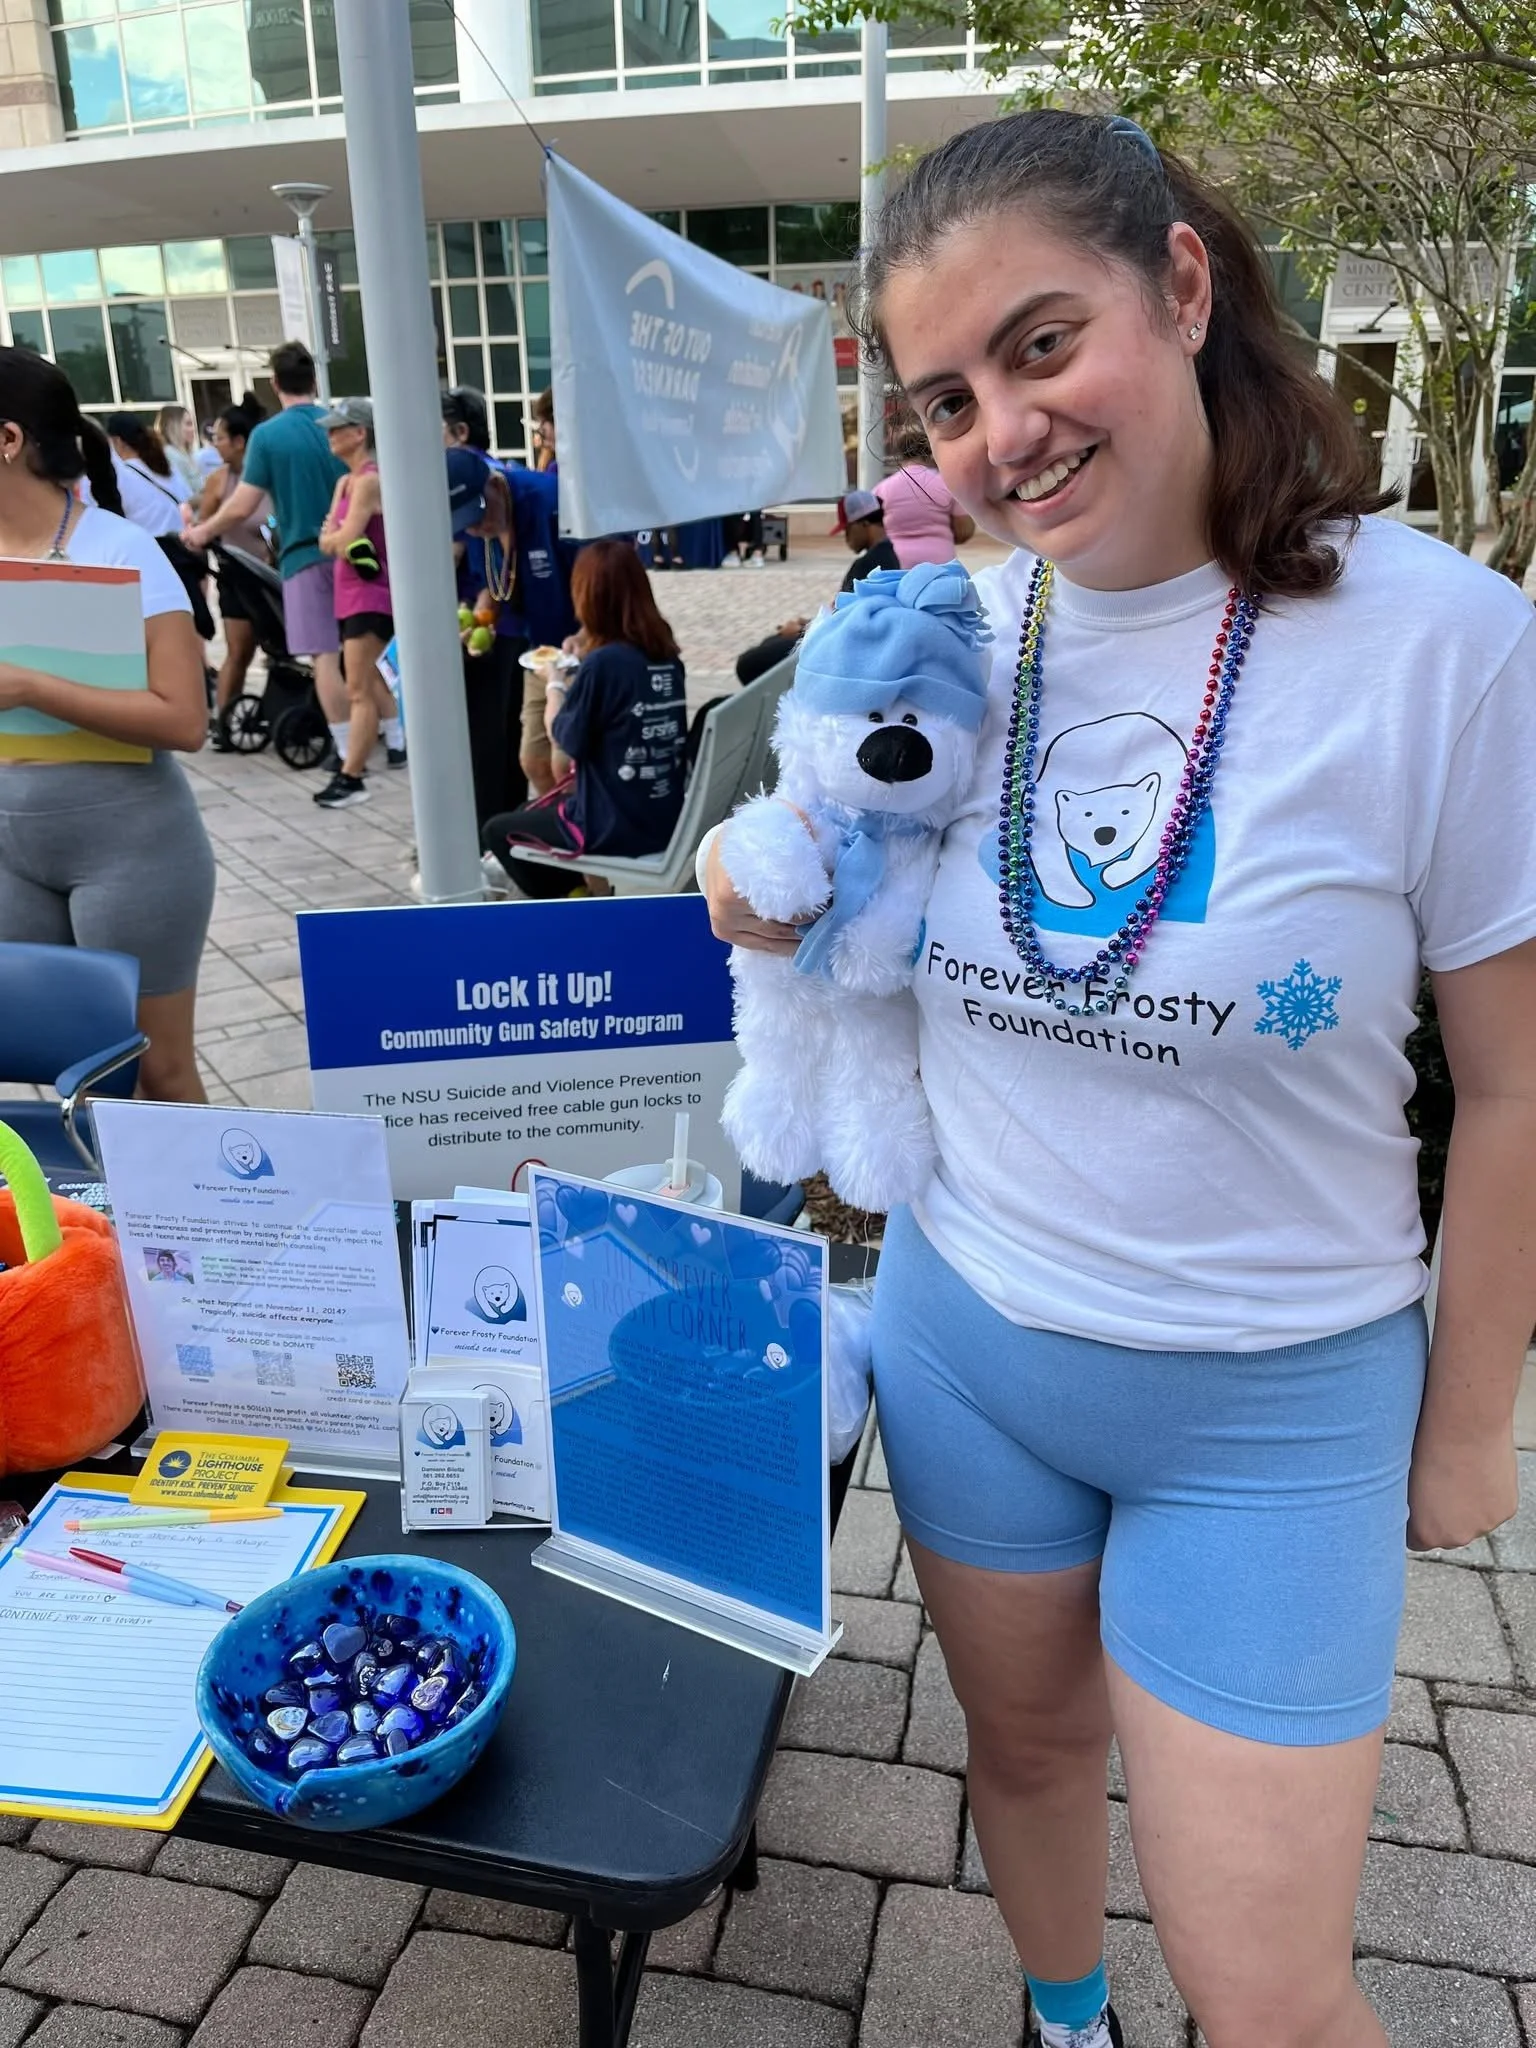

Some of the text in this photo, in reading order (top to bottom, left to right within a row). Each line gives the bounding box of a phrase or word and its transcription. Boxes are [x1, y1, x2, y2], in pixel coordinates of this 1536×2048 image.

[456, 971, 612, 1011] Lock it Up!
[928, 942, 1236, 1036] Forever Frosty
[380, 1013, 683, 1051] Community Gun Safety Program
[963, 998, 1181, 1066] Foundation
[364, 1070, 701, 1108] The NSU Suicide and Violence Prevention
[419, 1112, 449, 1127] has
[454, 1106, 523, 1123] received
[528, 1102, 558, 1117] free
[564, 1098, 604, 1114] cable
[610, 1099, 639, 1115] gun
[644, 1093, 682, 1109] locks
[686, 1092, 702, 1105] to
[428, 1118, 644, 1148] distribute to the community.
[201, 1184, 290, 1195] Forever Frosty Foundation
[125, 1211, 152, 1220] Forever
[155, 1213, 179, 1223] Frosty
[182, 1216, 220, 1225] Foundation
[224, 1219, 248, 1227] strives
[263, 1223, 293, 1231] continue
[361, 1229, 382, 1237] about
[127, 1222, 151, 1230] suicide
[205, 1228, 242, 1237] prevention
[244, 1230, 253, 1239] by
[254, 1231, 279, 1240] raising
[281, 1232, 301, 1240] funds
[314, 1234, 342, 1244] directly
[344, 1236, 368, 1246] impact
[371, 1239, 383, 1247] the
[129, 1230, 145, 1238] lives
[176, 1233, 190, 1241] who
[215, 1236, 240, 1245] afford
[241, 1238, 265, 1247] mental
[265, 1240, 288, 1249] health
[646, 1252, 732, 1311] FOREVER
[200, 1307, 298, 1322] Tragically, suicide affects
[217, 1300, 252, 1310] happened
[266, 1303, 303, 1312] November
[322, 1307, 346, 1315] 2014?
[592, 1278, 748, 1351] FROSTY CORNER
[226, 1336, 247, 1344] SCAN
[249, 1338, 271, 1347] CODE
[283, 1341, 315, 1350] DONATE
[440, 1328, 538, 1344] Forever Frosty Foundation
[182, 1399, 209, 1407] Forever
[210, 1401, 232, 1411] Frosty
[355, 1415, 380, 1424] charity
[203, 1409, 232, 1418] overhead
[241, 1412, 271, 1422] operating
[330, 1420, 355, 1429] parents
[355, 1423, 367, 1431] pay
[197, 1459, 264, 1472] LIGHTHOUSE
[200, 1451, 216, 1460] THE
[494, 1454, 535, 1469] Foundation
[150, 1478, 179, 1487] IDENTIFY
[198, 1481, 228, 1491] PREVENT
[193, 1469, 240, 1480] PROJECT
